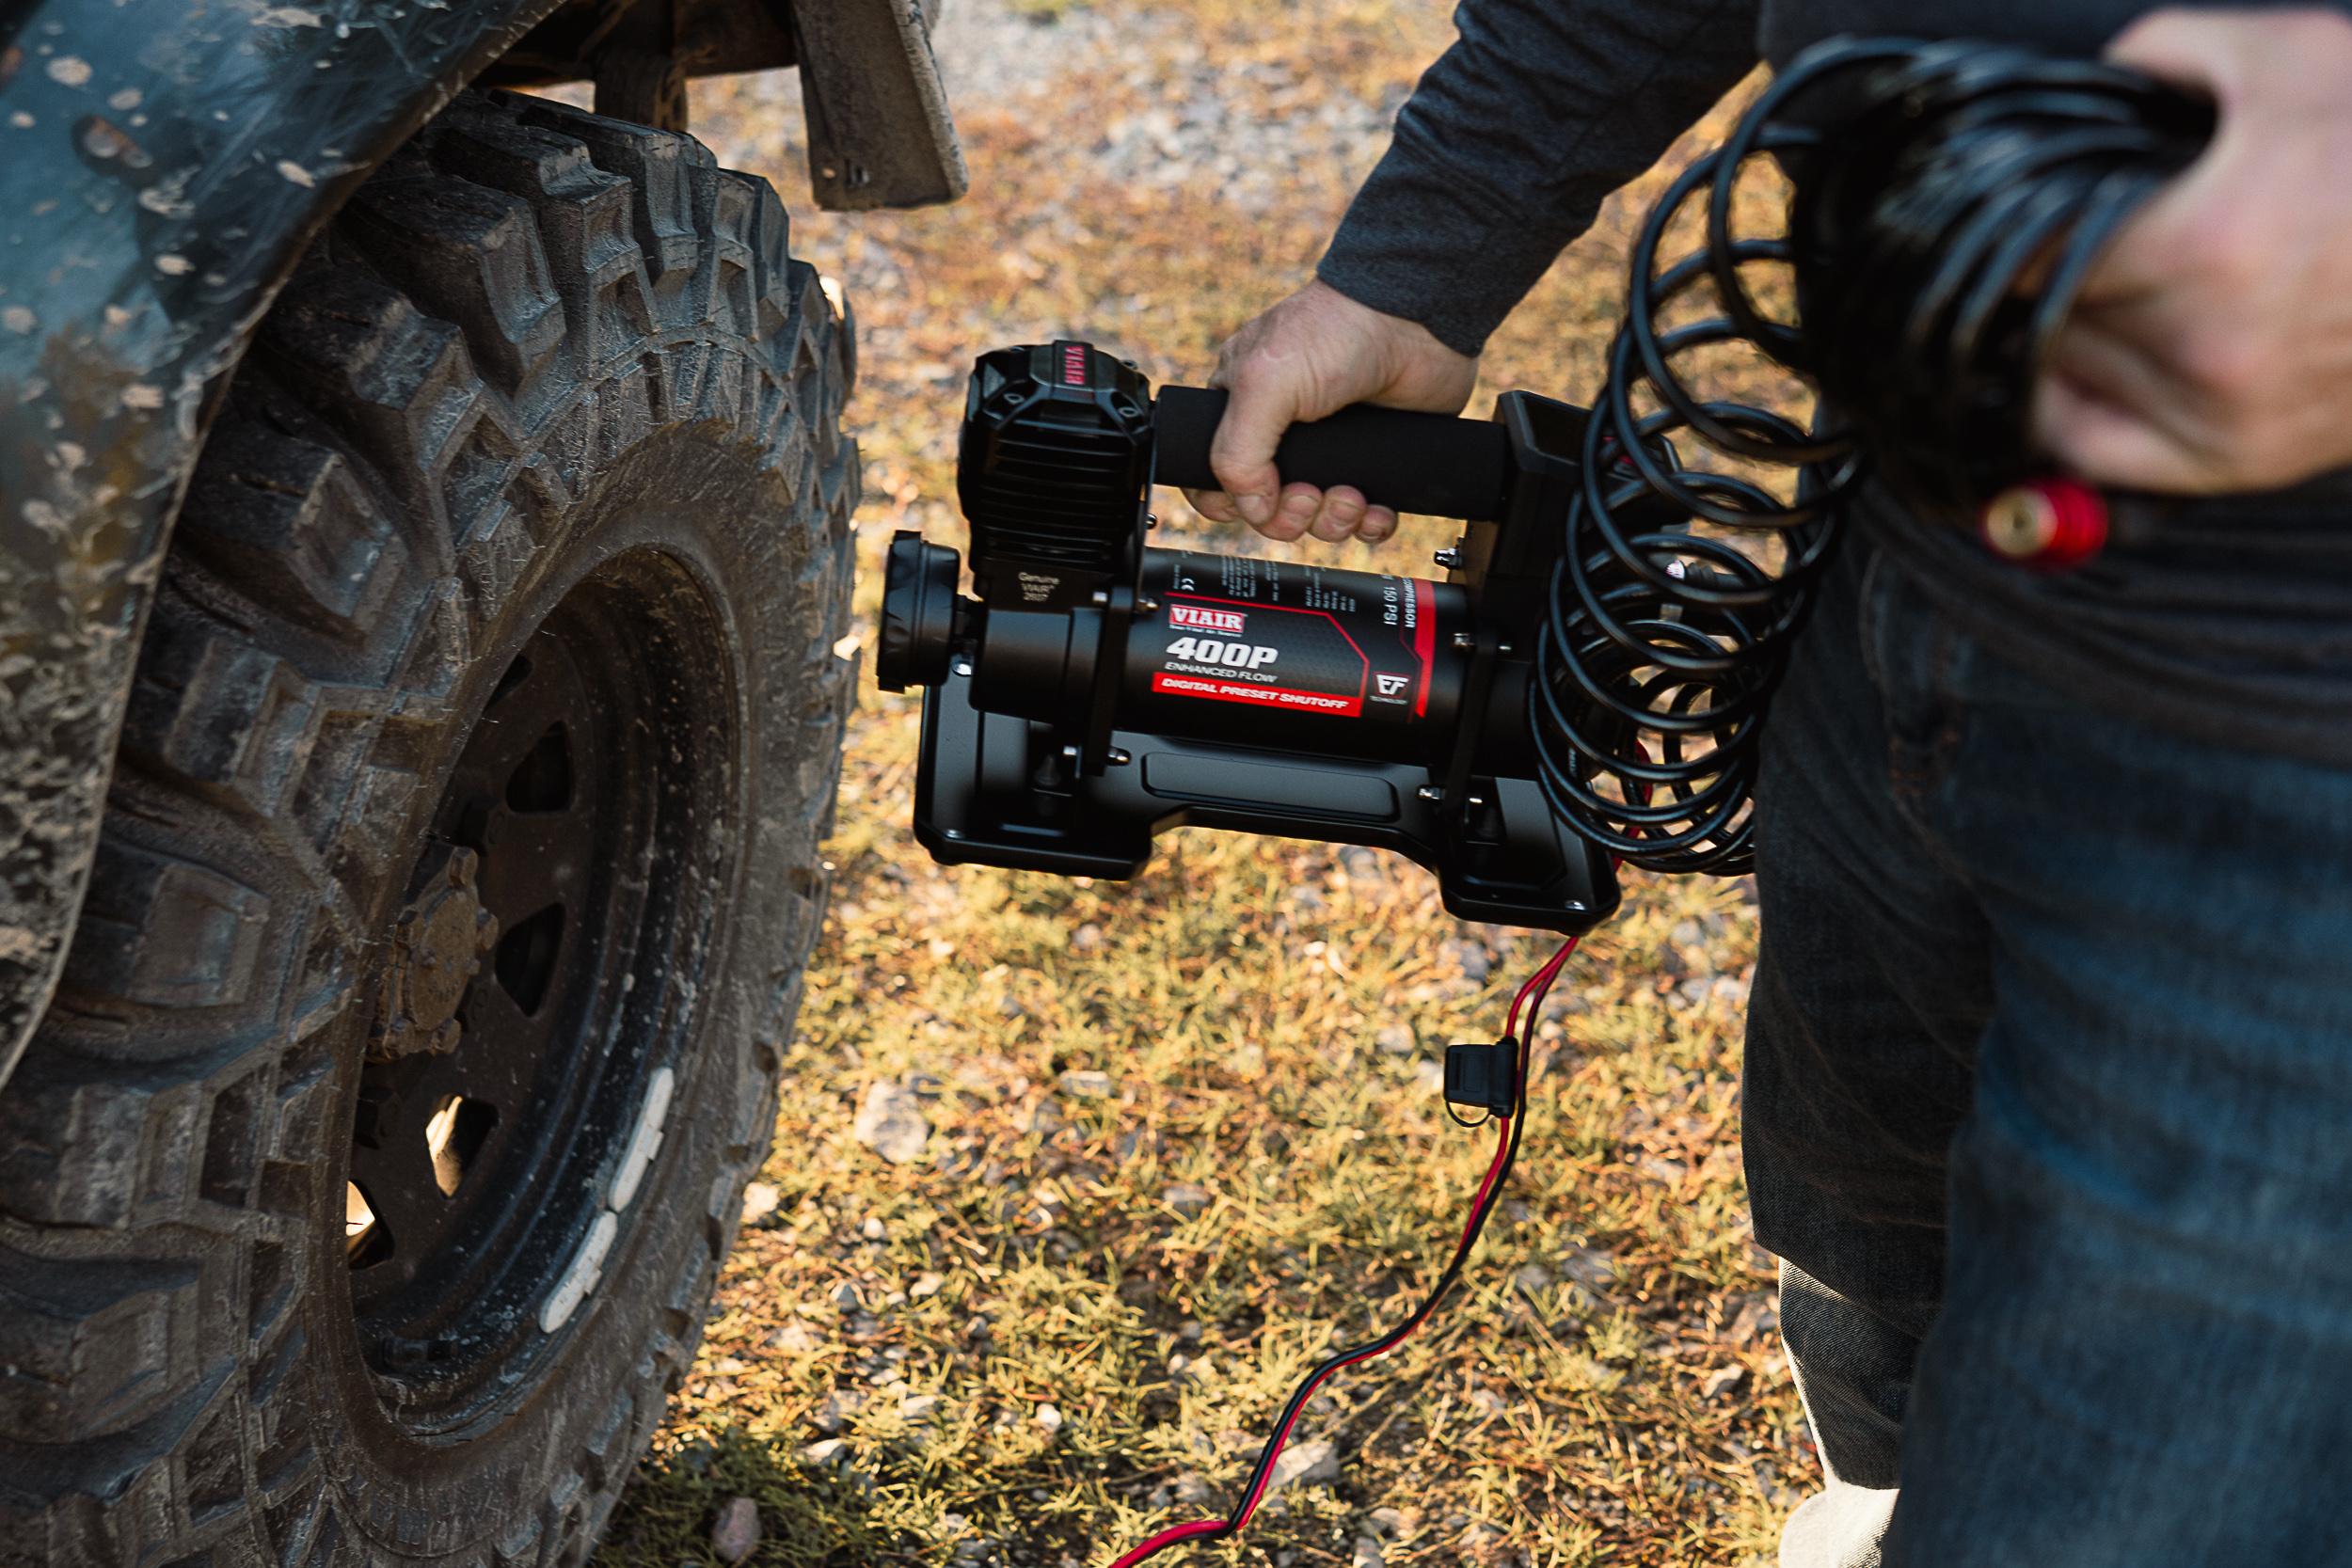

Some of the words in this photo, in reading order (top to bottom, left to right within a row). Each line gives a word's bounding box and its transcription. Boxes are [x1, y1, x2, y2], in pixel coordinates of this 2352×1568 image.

[1064, 345, 1085, 385] VIAIR
[1383, 586, 1398, 602] 150
[1402, 579, 1417, 628] COMPRESSOR
[1170, 607, 1243, 630] VIAIR
[1383, 604, 1398, 626] PSI
[1166, 637, 1279, 670] 400P
[1164, 661, 1238, 678] ENHANCED
[1237, 671, 1279, 683] FLOW
[1161, 678, 1218, 693] DIGITAL
[1218, 686, 1279, 701] PRESET
[1279, 692, 1349, 709] SHUTOFF
